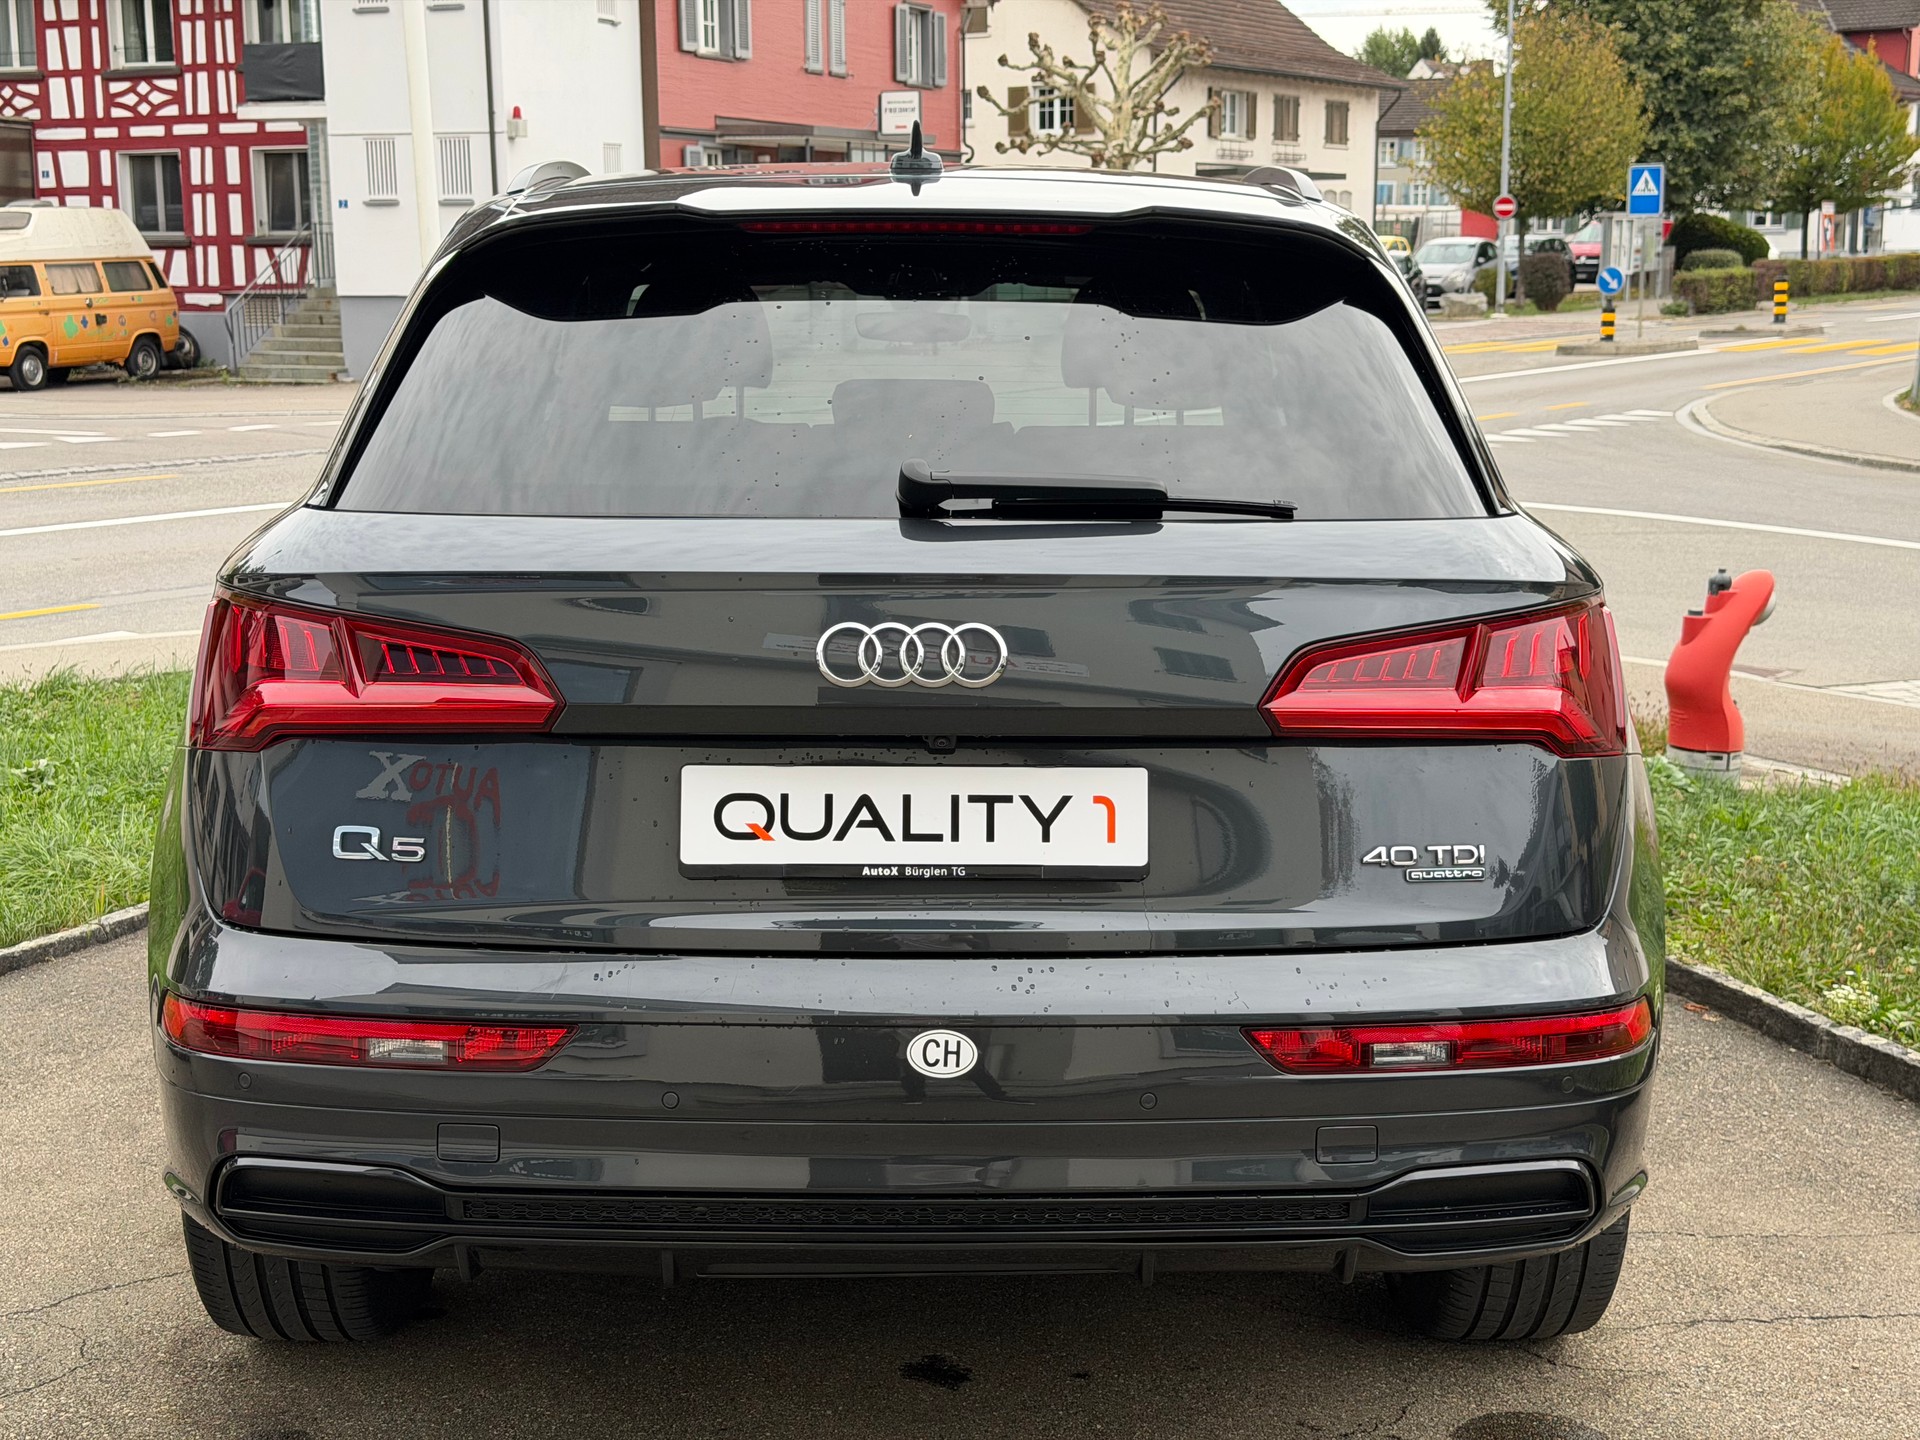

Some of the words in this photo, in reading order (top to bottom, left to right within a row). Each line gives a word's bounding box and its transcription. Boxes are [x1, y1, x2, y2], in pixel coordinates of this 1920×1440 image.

[714, 793, 1073, 842] QUALITY
[1092, 795, 1116, 843] 1
[332, 825, 426, 862] Q5
[1362, 846, 1418, 866] 40
[1426, 845, 1485, 865] TDI
[862, 866, 899, 876] AutoX
[905, 866, 947, 878] Bürglen
[951, 866, 966, 876] TG
[1411, 869, 1483, 880] quattro
[922, 1038, 961, 1068] CH
